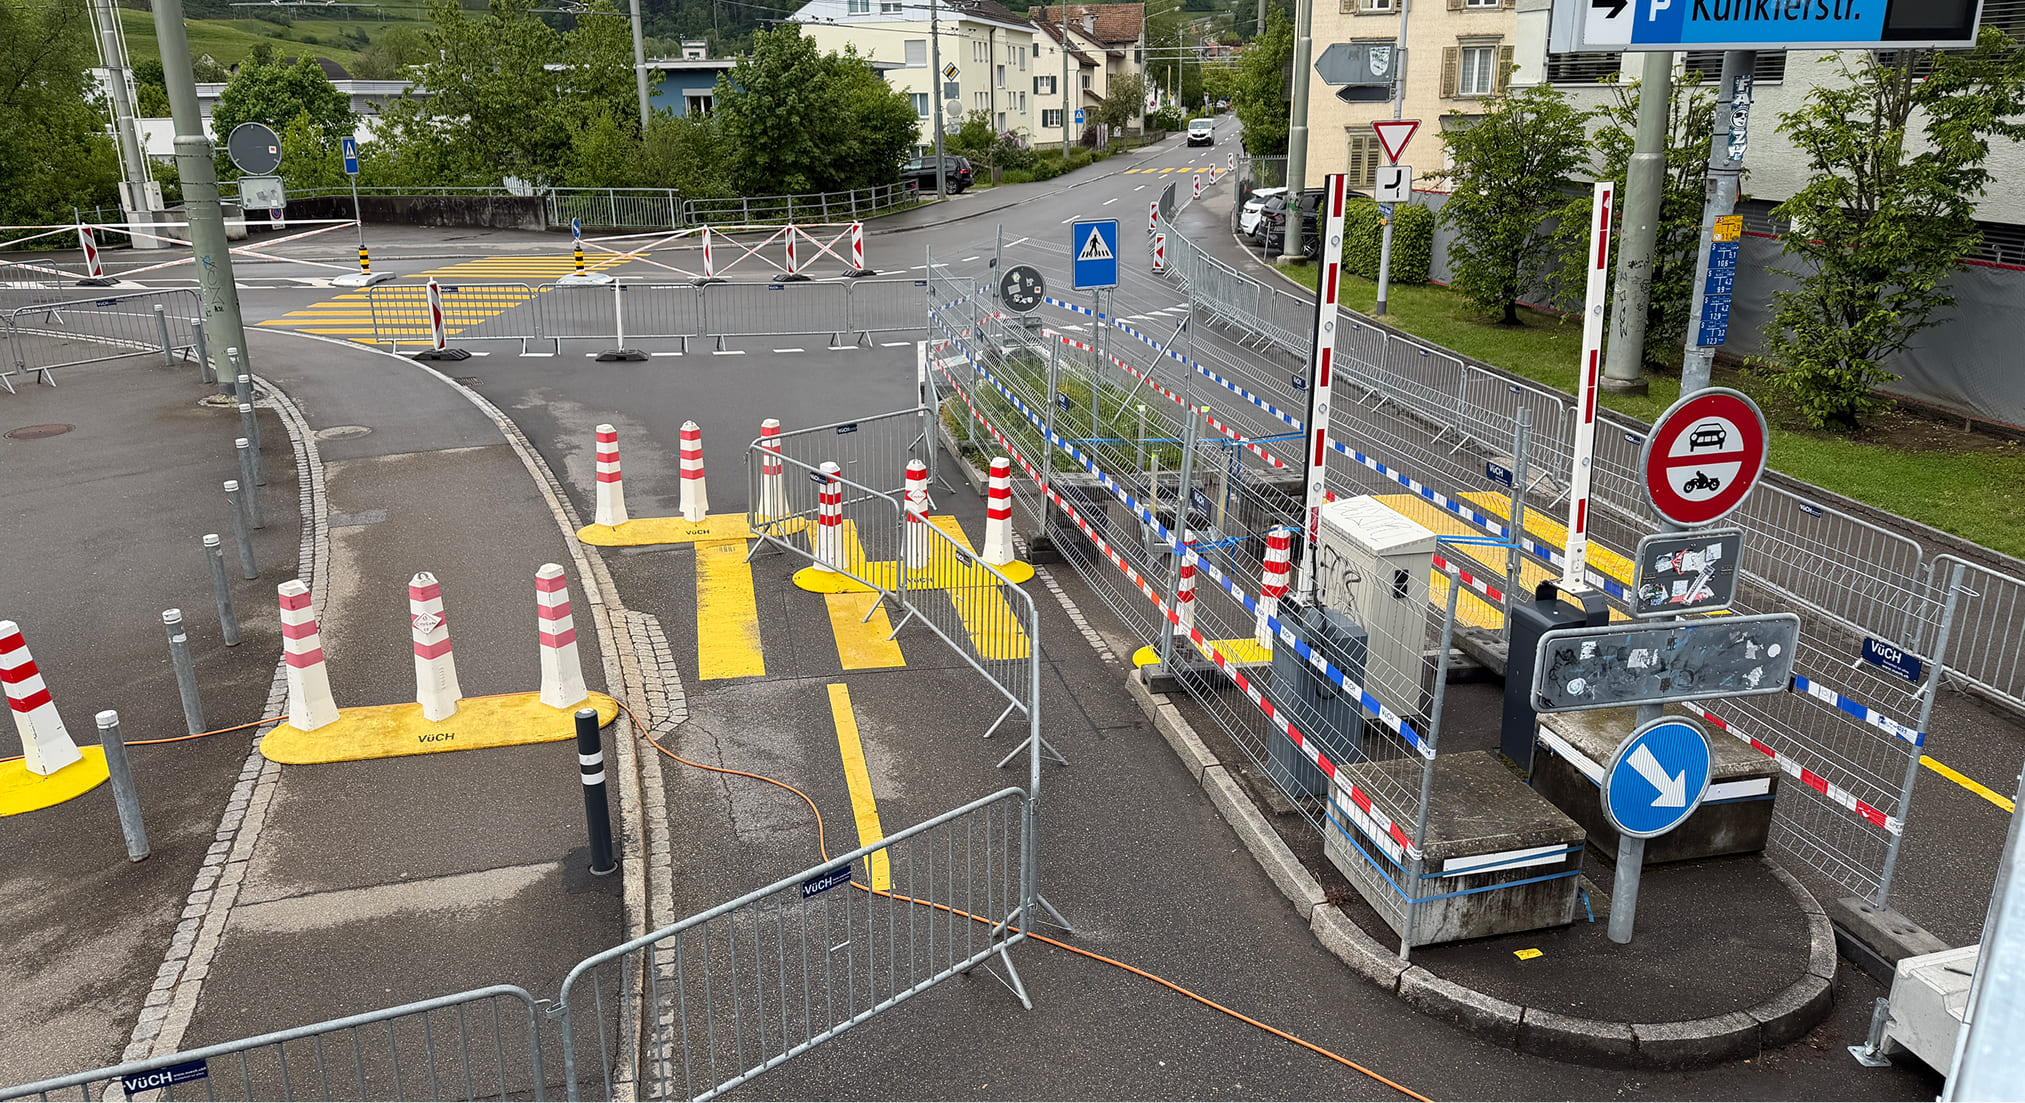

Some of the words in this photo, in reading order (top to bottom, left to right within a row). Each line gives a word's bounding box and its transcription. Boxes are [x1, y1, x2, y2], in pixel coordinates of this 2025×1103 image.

[1871, 640, 1902, 664] VüCH
[418, 732, 455, 743] VüCH
[804, 876, 832, 894] VüCH
[125, 1071, 173, 1091] VüCH
